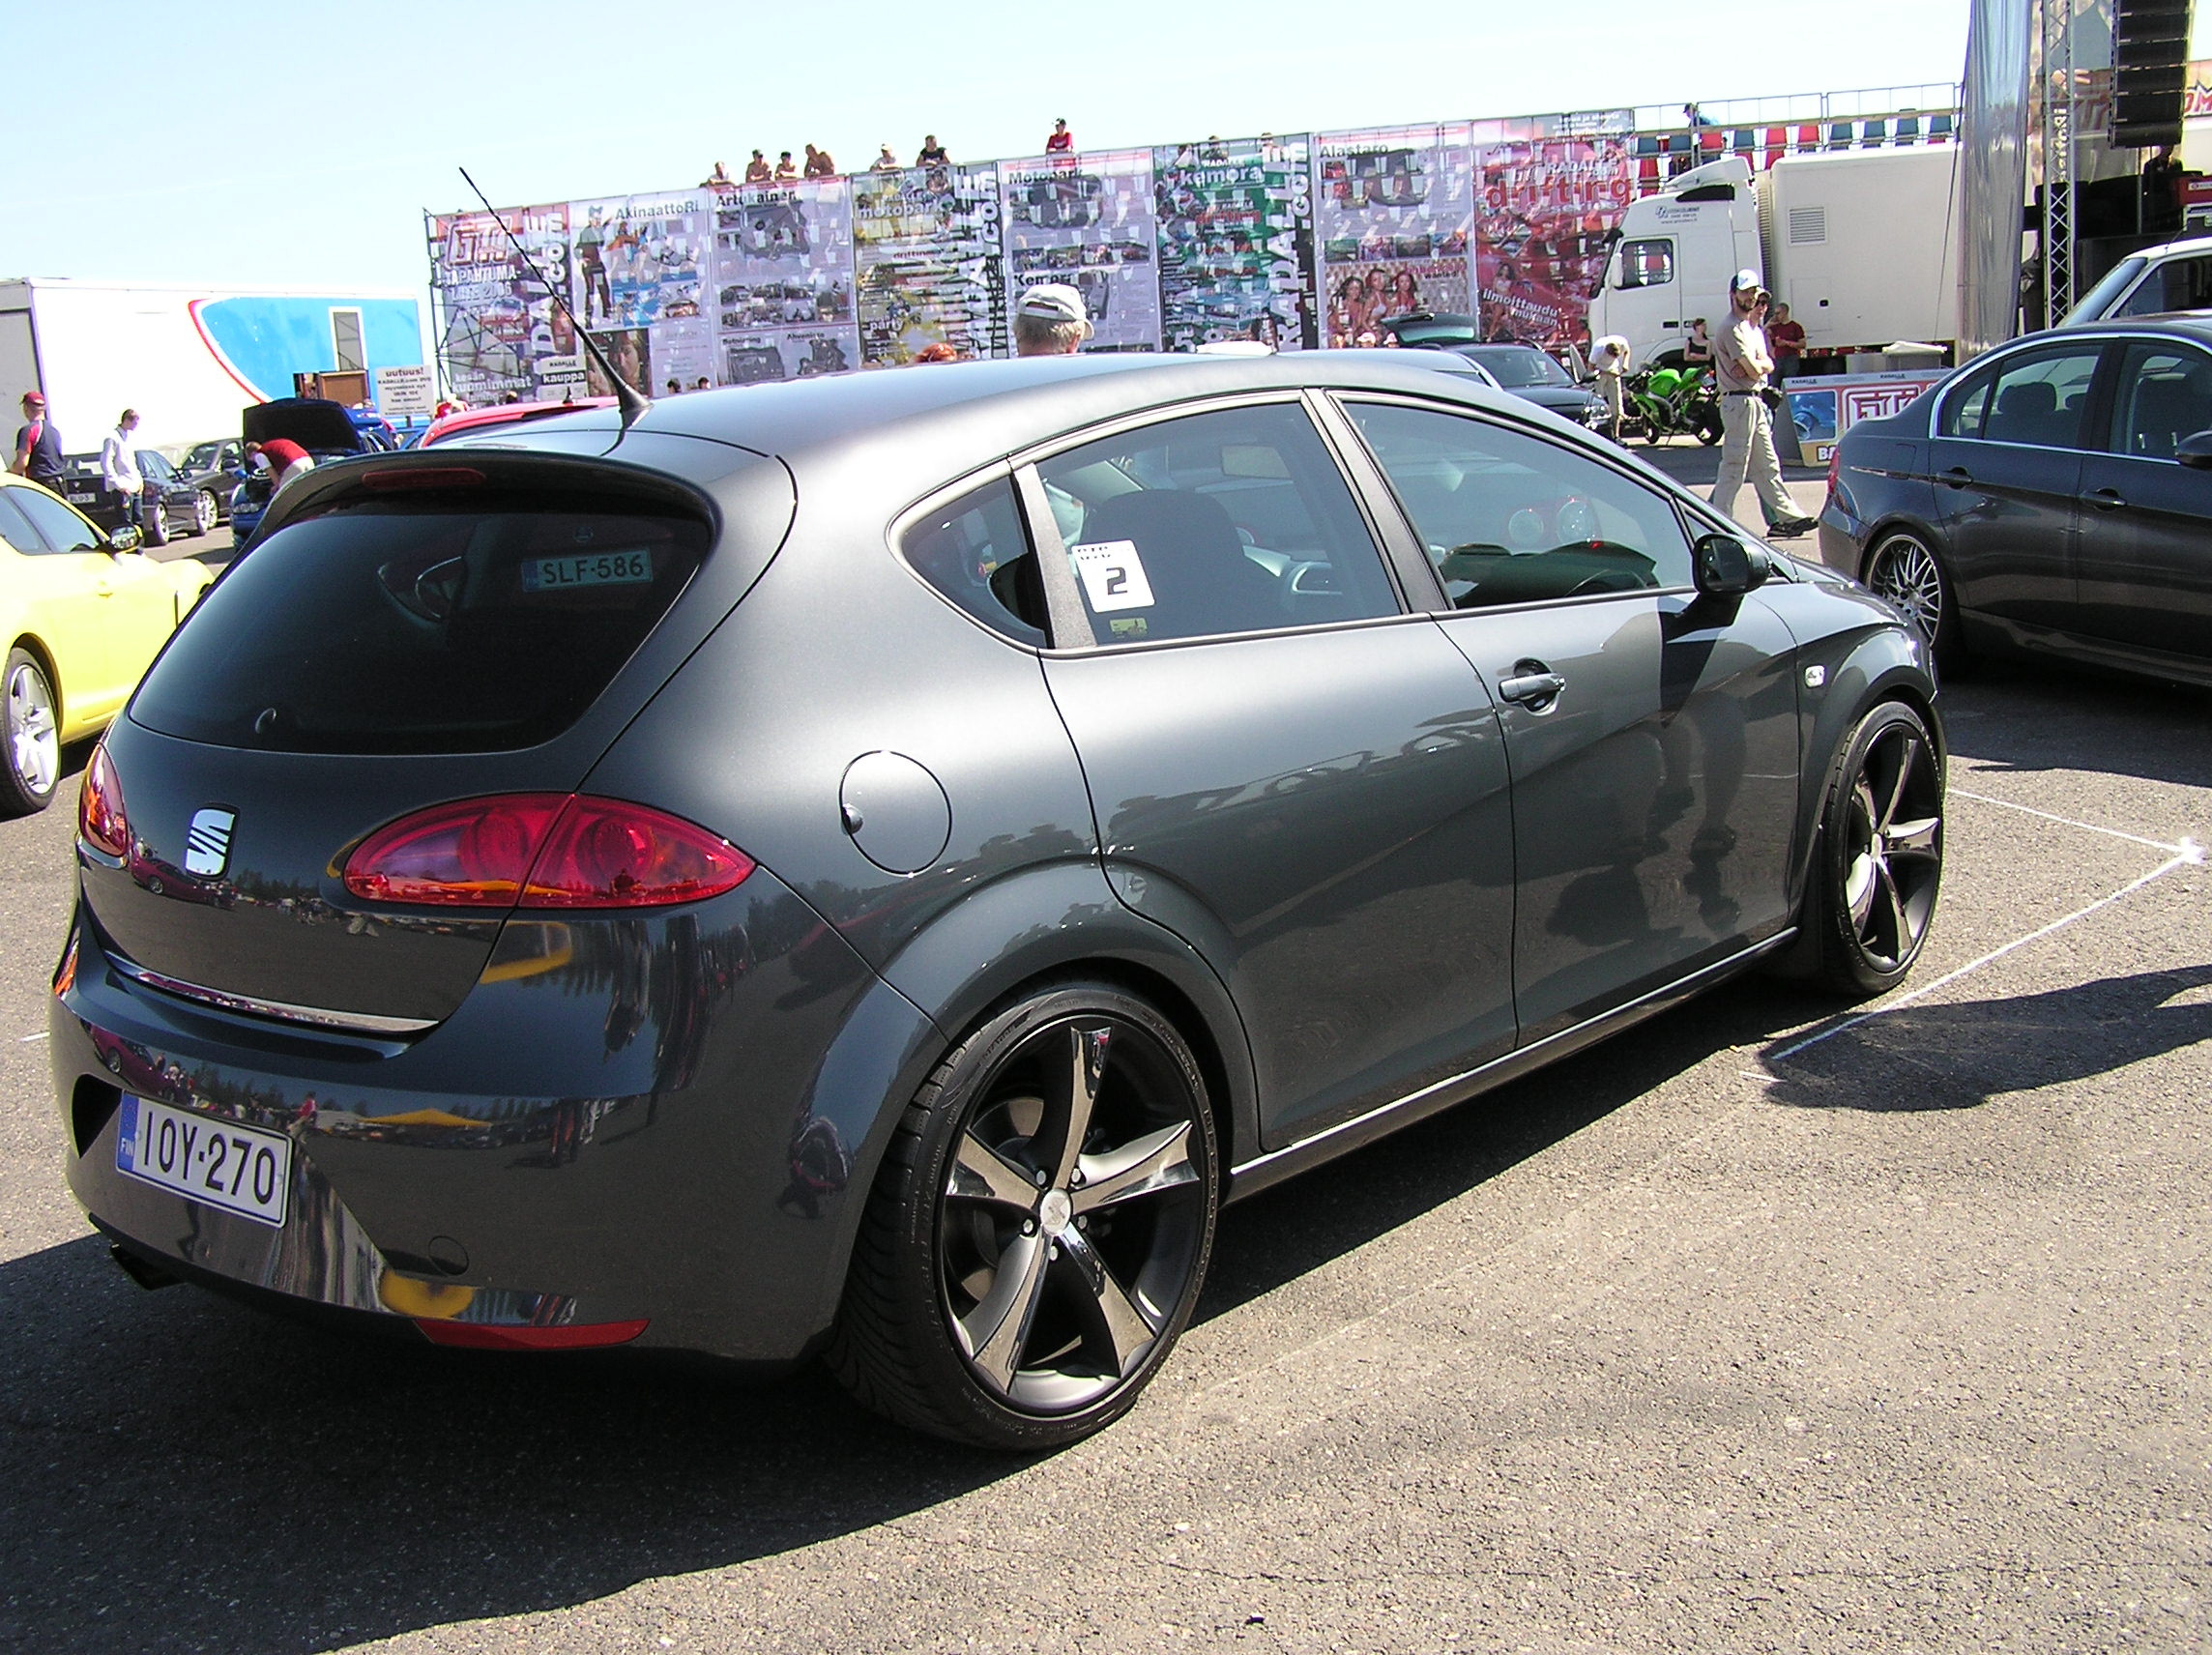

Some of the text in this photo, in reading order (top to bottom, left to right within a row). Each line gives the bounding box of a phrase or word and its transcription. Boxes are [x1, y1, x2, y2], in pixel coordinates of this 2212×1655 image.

[1320, 144, 1388, 159] Alastaro
[1008, 167, 1082, 185] Motopark
[1179, 164, 1265, 186] kemora
[716, 189, 798, 207] Artukainen
[1485, 176, 1632, 208] drifting
[616, 199, 698, 221] AkinaattoRi
[857, 197, 948, 219] motopark
[1482, 288, 1559, 318] ilmoittaudu
[869, 313, 904, 333] party
[1510, 308, 1559, 328] mukaan
[386, 366, 423, 377] uutuus!
[542, 371, 585, 385] kauppa
[543, 554, 645, 585] SLF-586
[1105, 566, 1128, 596] 2
[144, 1111, 276, 1205] IOY-270
